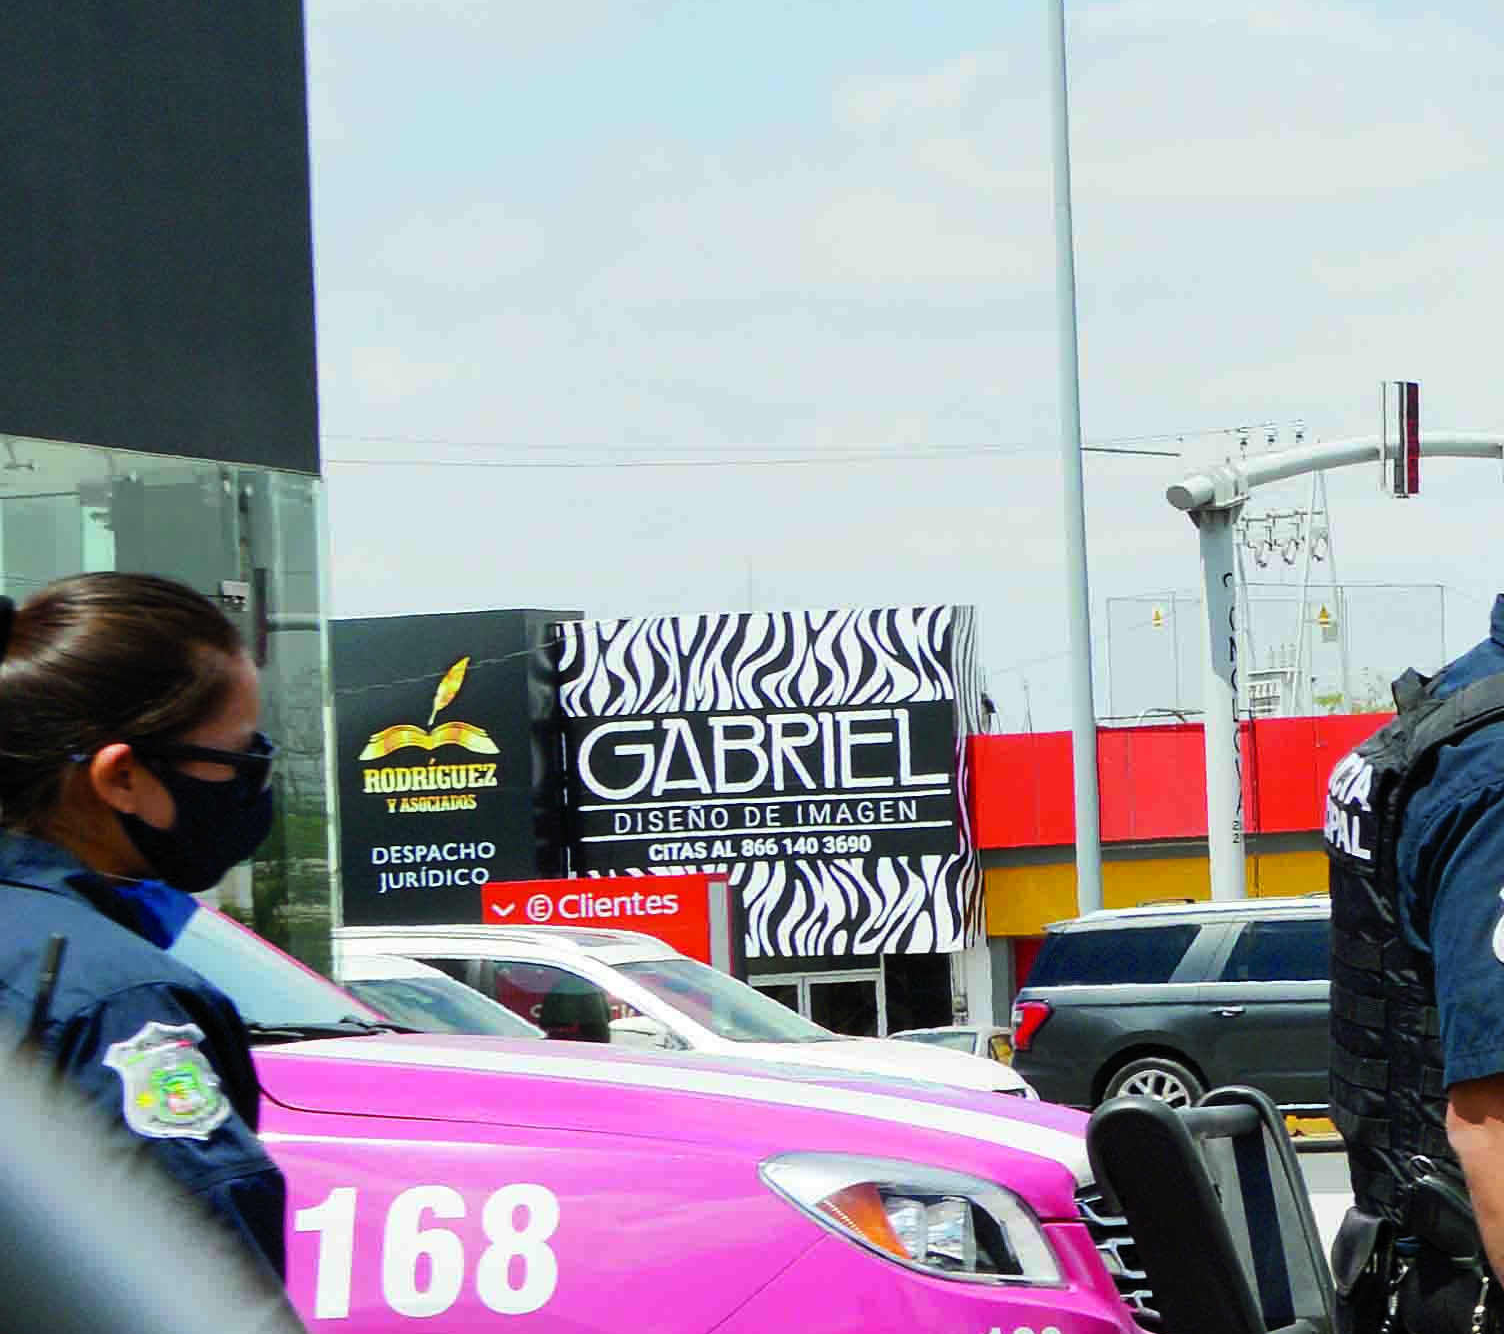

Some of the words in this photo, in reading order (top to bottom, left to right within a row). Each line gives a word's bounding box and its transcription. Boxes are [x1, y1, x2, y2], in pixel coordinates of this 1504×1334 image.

[578, 708, 949, 800] GABRIEL
[362, 758, 498, 793] RODRÍGUEZ
[386, 798, 397, 813] Y
[399, 794, 477, 813] ASOCIADOS
[614, 805, 728, 834] DISEÑO
[744, 805, 780, 827] DE
[797, 800, 917, 825] IMAGEN
[371, 841, 496, 865] DESPACHO
[649, 840, 707, 862] CITAS
[711, 840, 732, 858] AL
[741, 838, 778, 857] 866
[783, 836, 819, 854] 140
[823, 834, 871, 854] 3690
[378, 867, 489, 893] JURÍDICO
[558, 892, 679, 918] Clientes
[293, 1183, 560, 1320] 168
